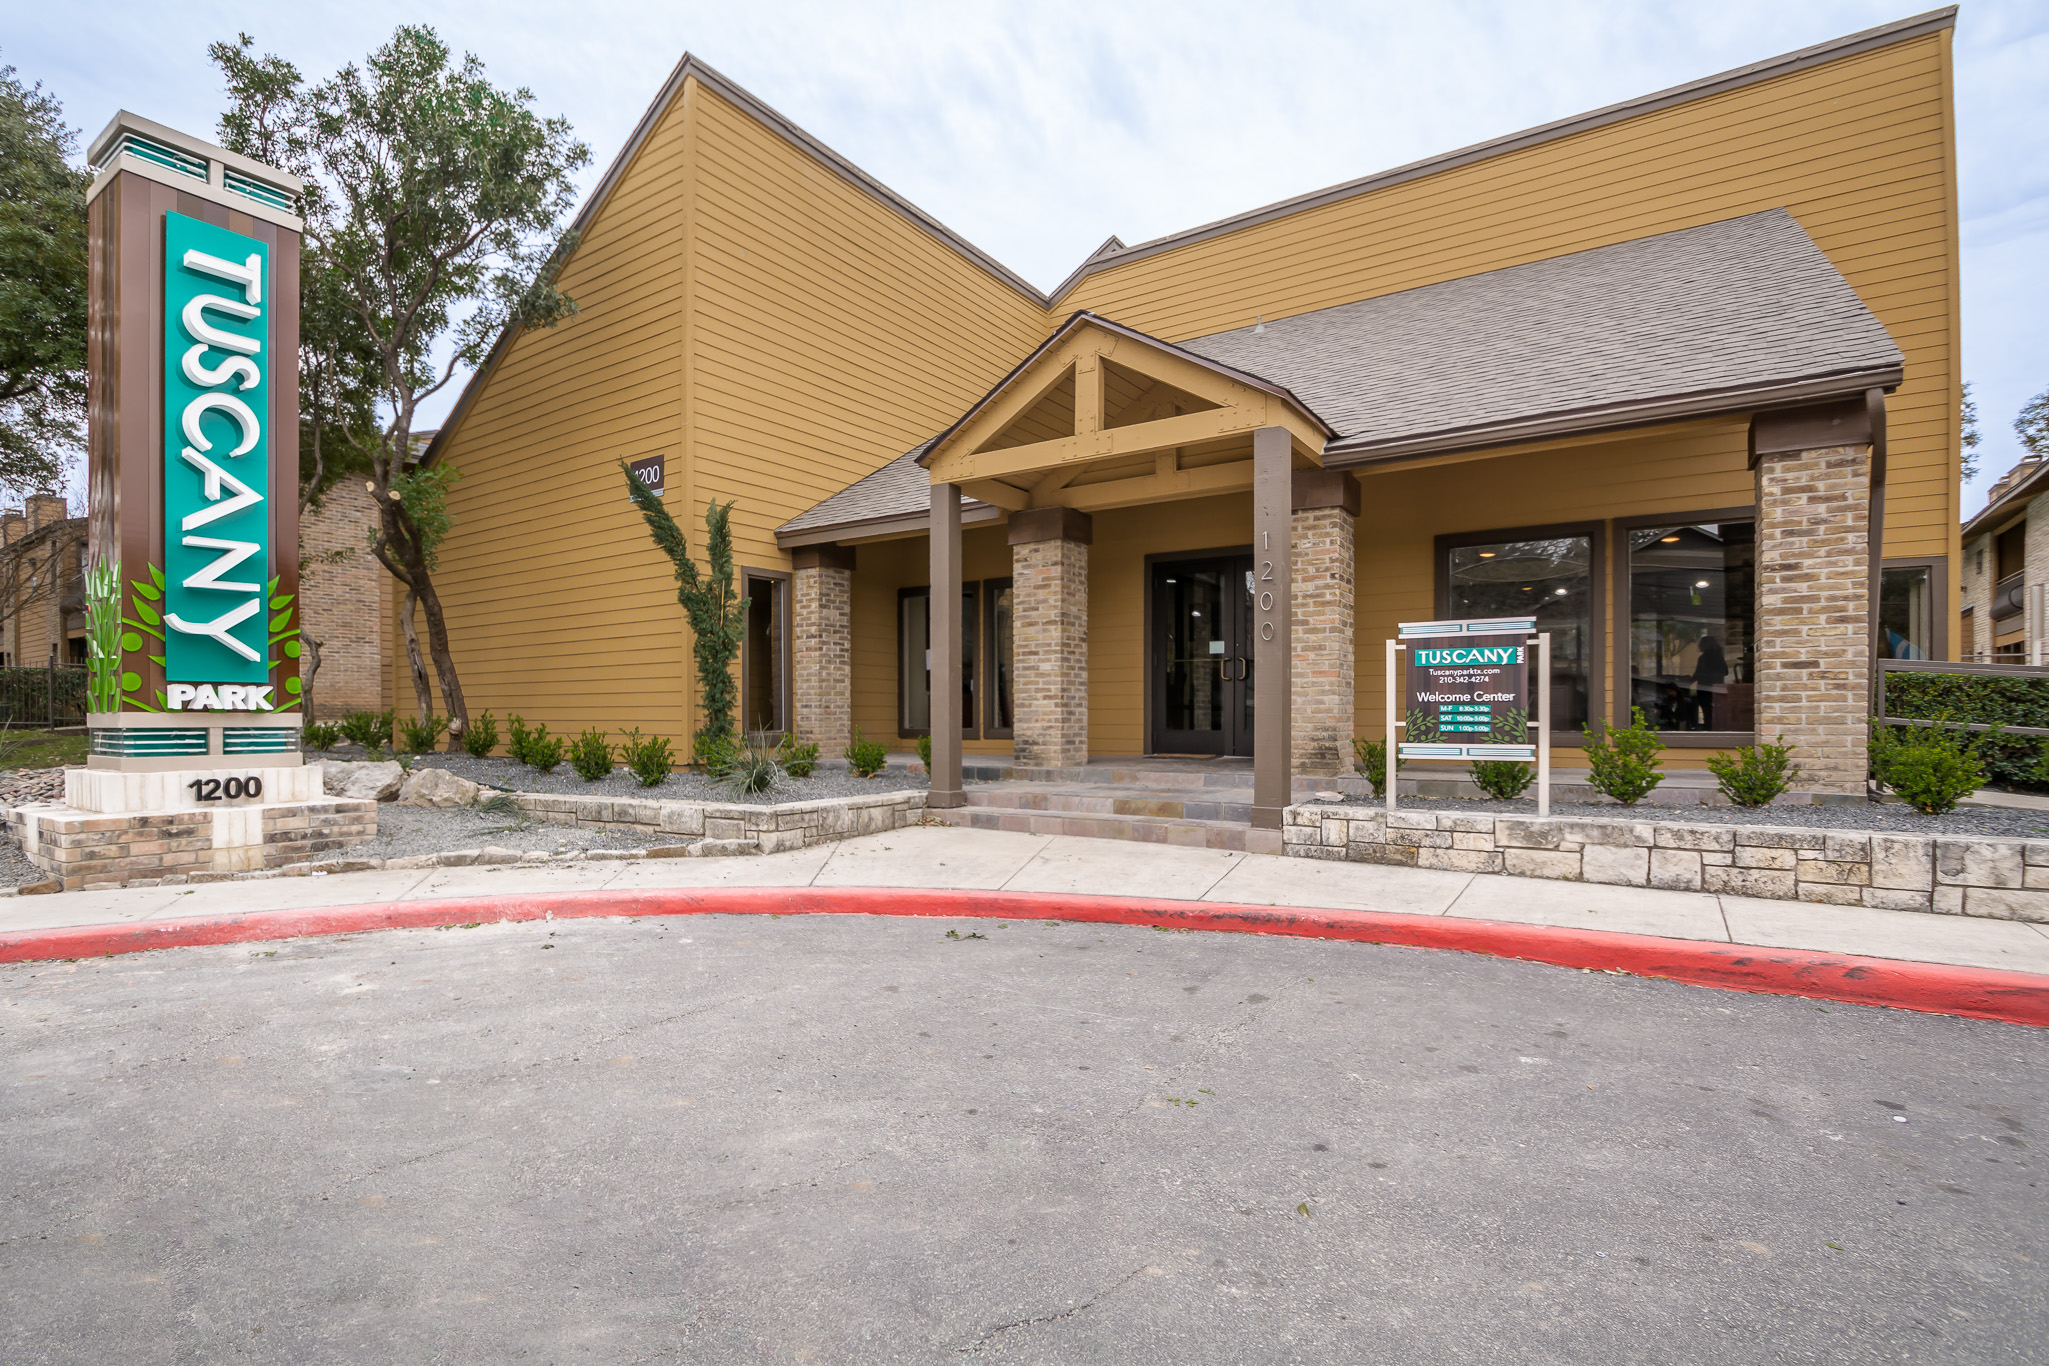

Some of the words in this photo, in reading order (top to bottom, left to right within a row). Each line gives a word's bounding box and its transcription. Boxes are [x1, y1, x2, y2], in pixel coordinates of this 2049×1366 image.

[163, 247, 264, 663] TUSCANY
[1260, 531, 1274, 641] 1200
[1418, 648, 1513, 665] TUSCANY
[1516, 646, 1525, 664] PARK
[1429, 668, 1501, 677] Tuscanyparktx.com
[1439, 676, 1489, 684] 210-342-4274
[166, 683, 274, 711] PARK
[1416, 691, 1471, 703] Welcome
[1473, 691, 1516, 702] Center
[187, 776, 263, 802] 1200
